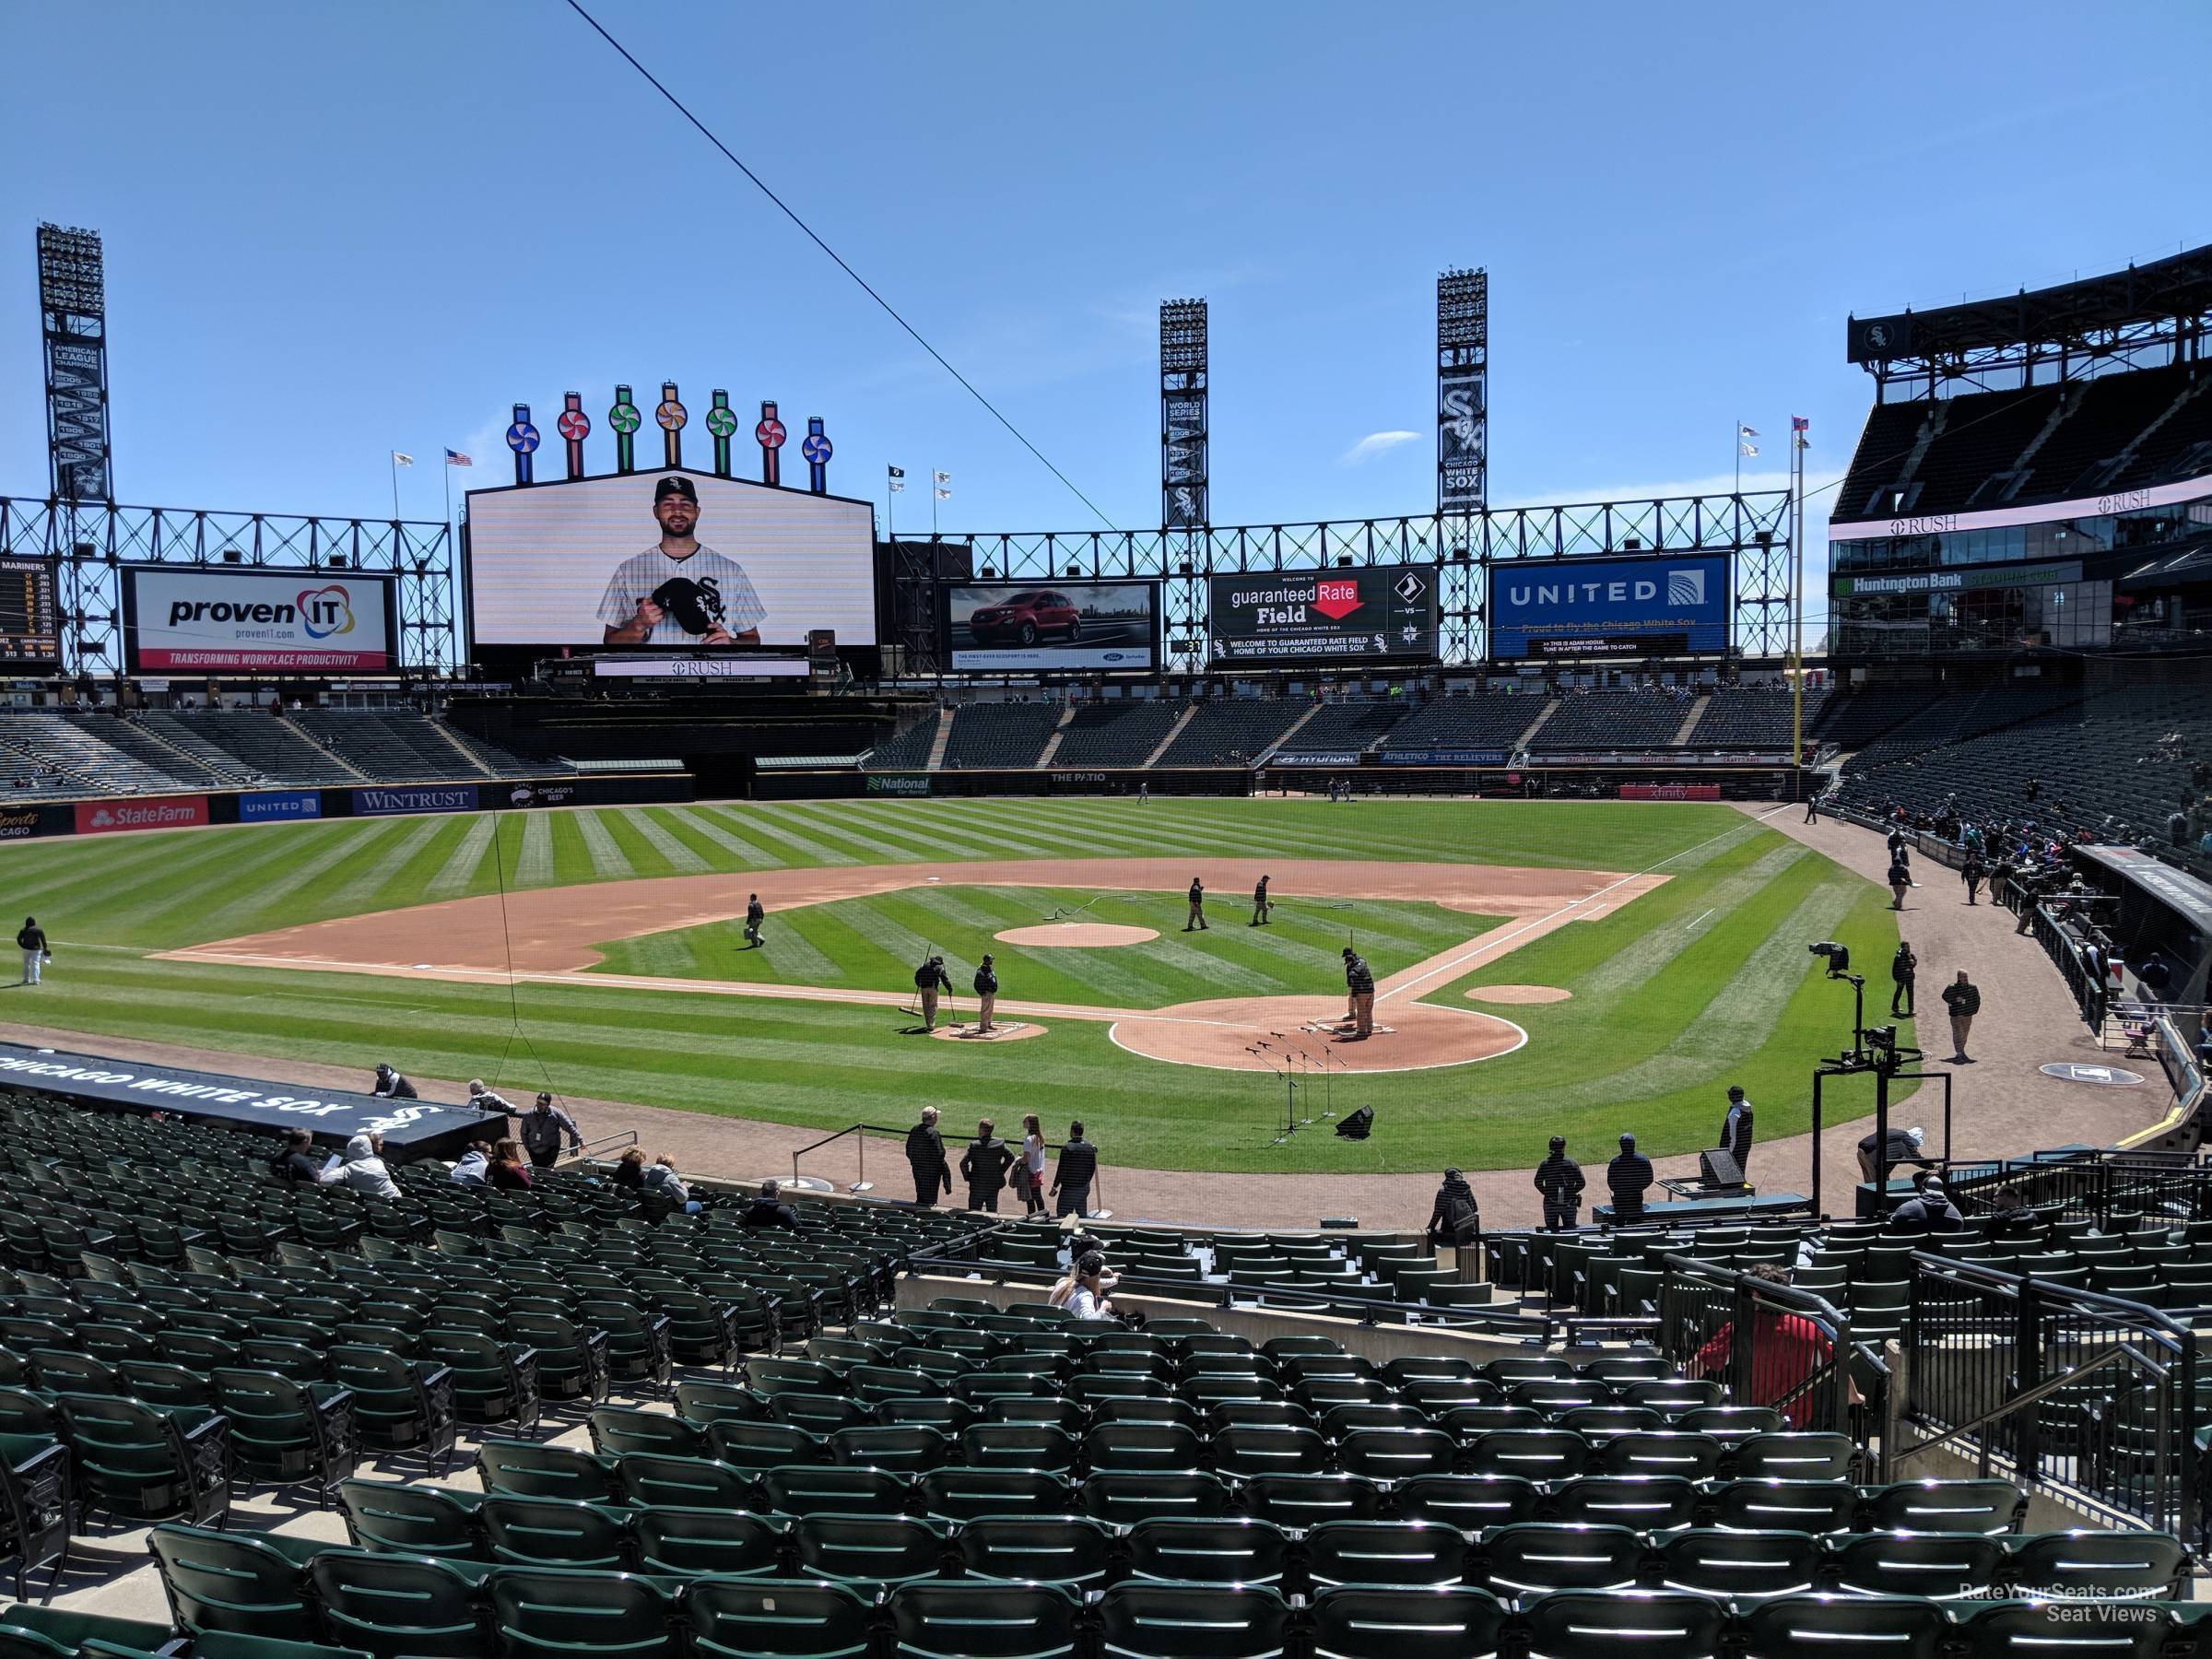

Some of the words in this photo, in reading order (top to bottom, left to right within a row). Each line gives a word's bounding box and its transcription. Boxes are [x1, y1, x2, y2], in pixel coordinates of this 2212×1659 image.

[55, 346, 98, 356] AMERICAN
[55, 352, 98, 364] LEAGUE
[55, 359, 98, 370] CHAMPIONS
[1169, 401, 1200, 409] WORLD
[1169, 408, 1200, 417] SERIES
[1445, 460, 1478, 468] CHICAGO
[1445, 467, 1478, 477] WHITE
[1445, 475, 1478, 488] SOX
[2113, 489, 2150, 512] RUSH
[1909, 515, 1958, 534] RUSH
[2, 561, 46, 571] MARINERS
[1854, 576, 1929, 594] Huntington
[1929, 573, 1962, 587] Bank
[1231, 585, 1316, 608] guaranteed
[1319, 584, 1355, 601] Rate
[1510, 581, 1657, 606] UNITED
[169, 600, 296, 627] proven
[312, 601, 339, 624] IT
[1257, 605, 1307, 624] Field
[236, 629, 295, 640] provenIT.com
[1230, 640, 1266, 648] WELCOME
[1278, 638, 1328, 647] GUARANTEED
[1328, 637, 1347, 645] RATE
[1233, 647, 1255, 655] HOME
[1290, 645, 1323, 653] CHICAGO
[1324, 644, 1347, 653] WHITE
[170, 653, 240, 665] TRANSFORMING
[241, 653, 295, 665] WORKPLACE
[297, 654, 359, 665] PRODUCTIVITY
[688, 662, 733, 675] RUSH
[1300, 755, 1354, 763] HYUNDAI
[1383, 751, 1430, 760] ATHLETICO
[1453, 753, 1503, 761] RELIEVERS
[1051, 773, 1072, 782] THE
[1075, 772, 1106, 782] PATIO
[880, 777, 930, 790] National
[537, 787, 574, 795] CHICAGO'S
[1651, 787, 1688, 799] xfinity
[362, 791, 468, 810] WINTRUST
[246, 802, 300, 813] UNITED
[127, 1077, 264, 1103] WHITE
[252, 1096, 354, 1117] SOX
